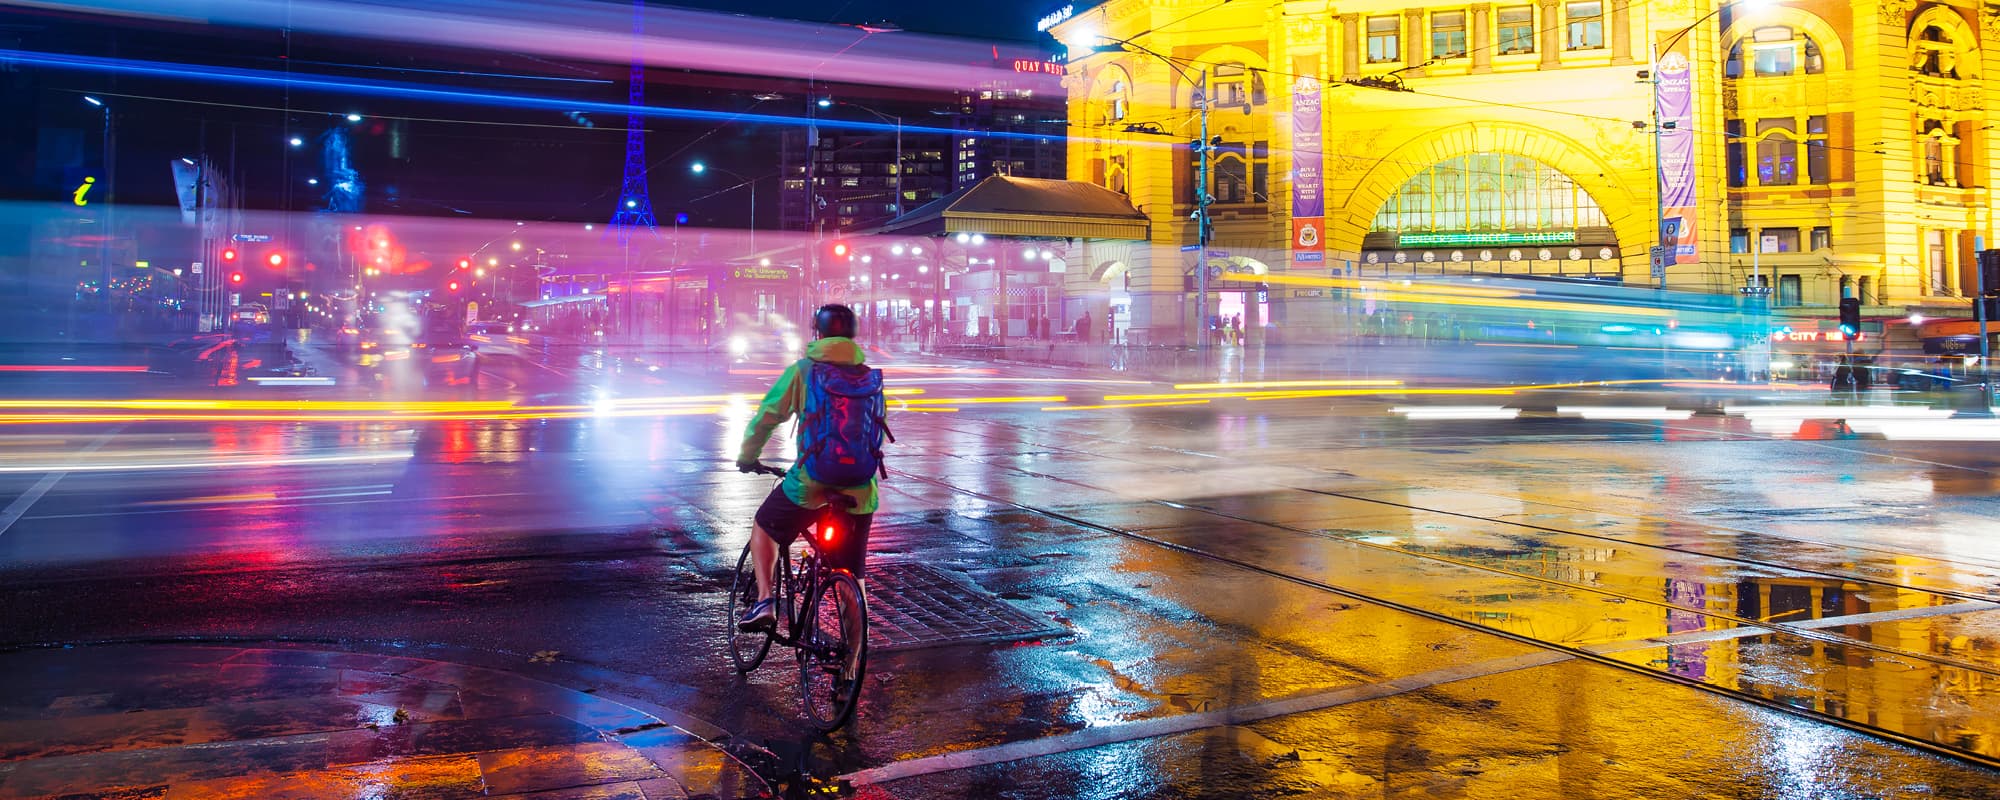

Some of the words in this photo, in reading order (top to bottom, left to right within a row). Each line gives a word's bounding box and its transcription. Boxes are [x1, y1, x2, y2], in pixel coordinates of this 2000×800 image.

[1014, 60, 1040, 73] QUAY
[1467, 234, 1509, 243] STREET
[1523, 232, 1576, 241] STATION
[1789, 331, 1819, 341] CITY
